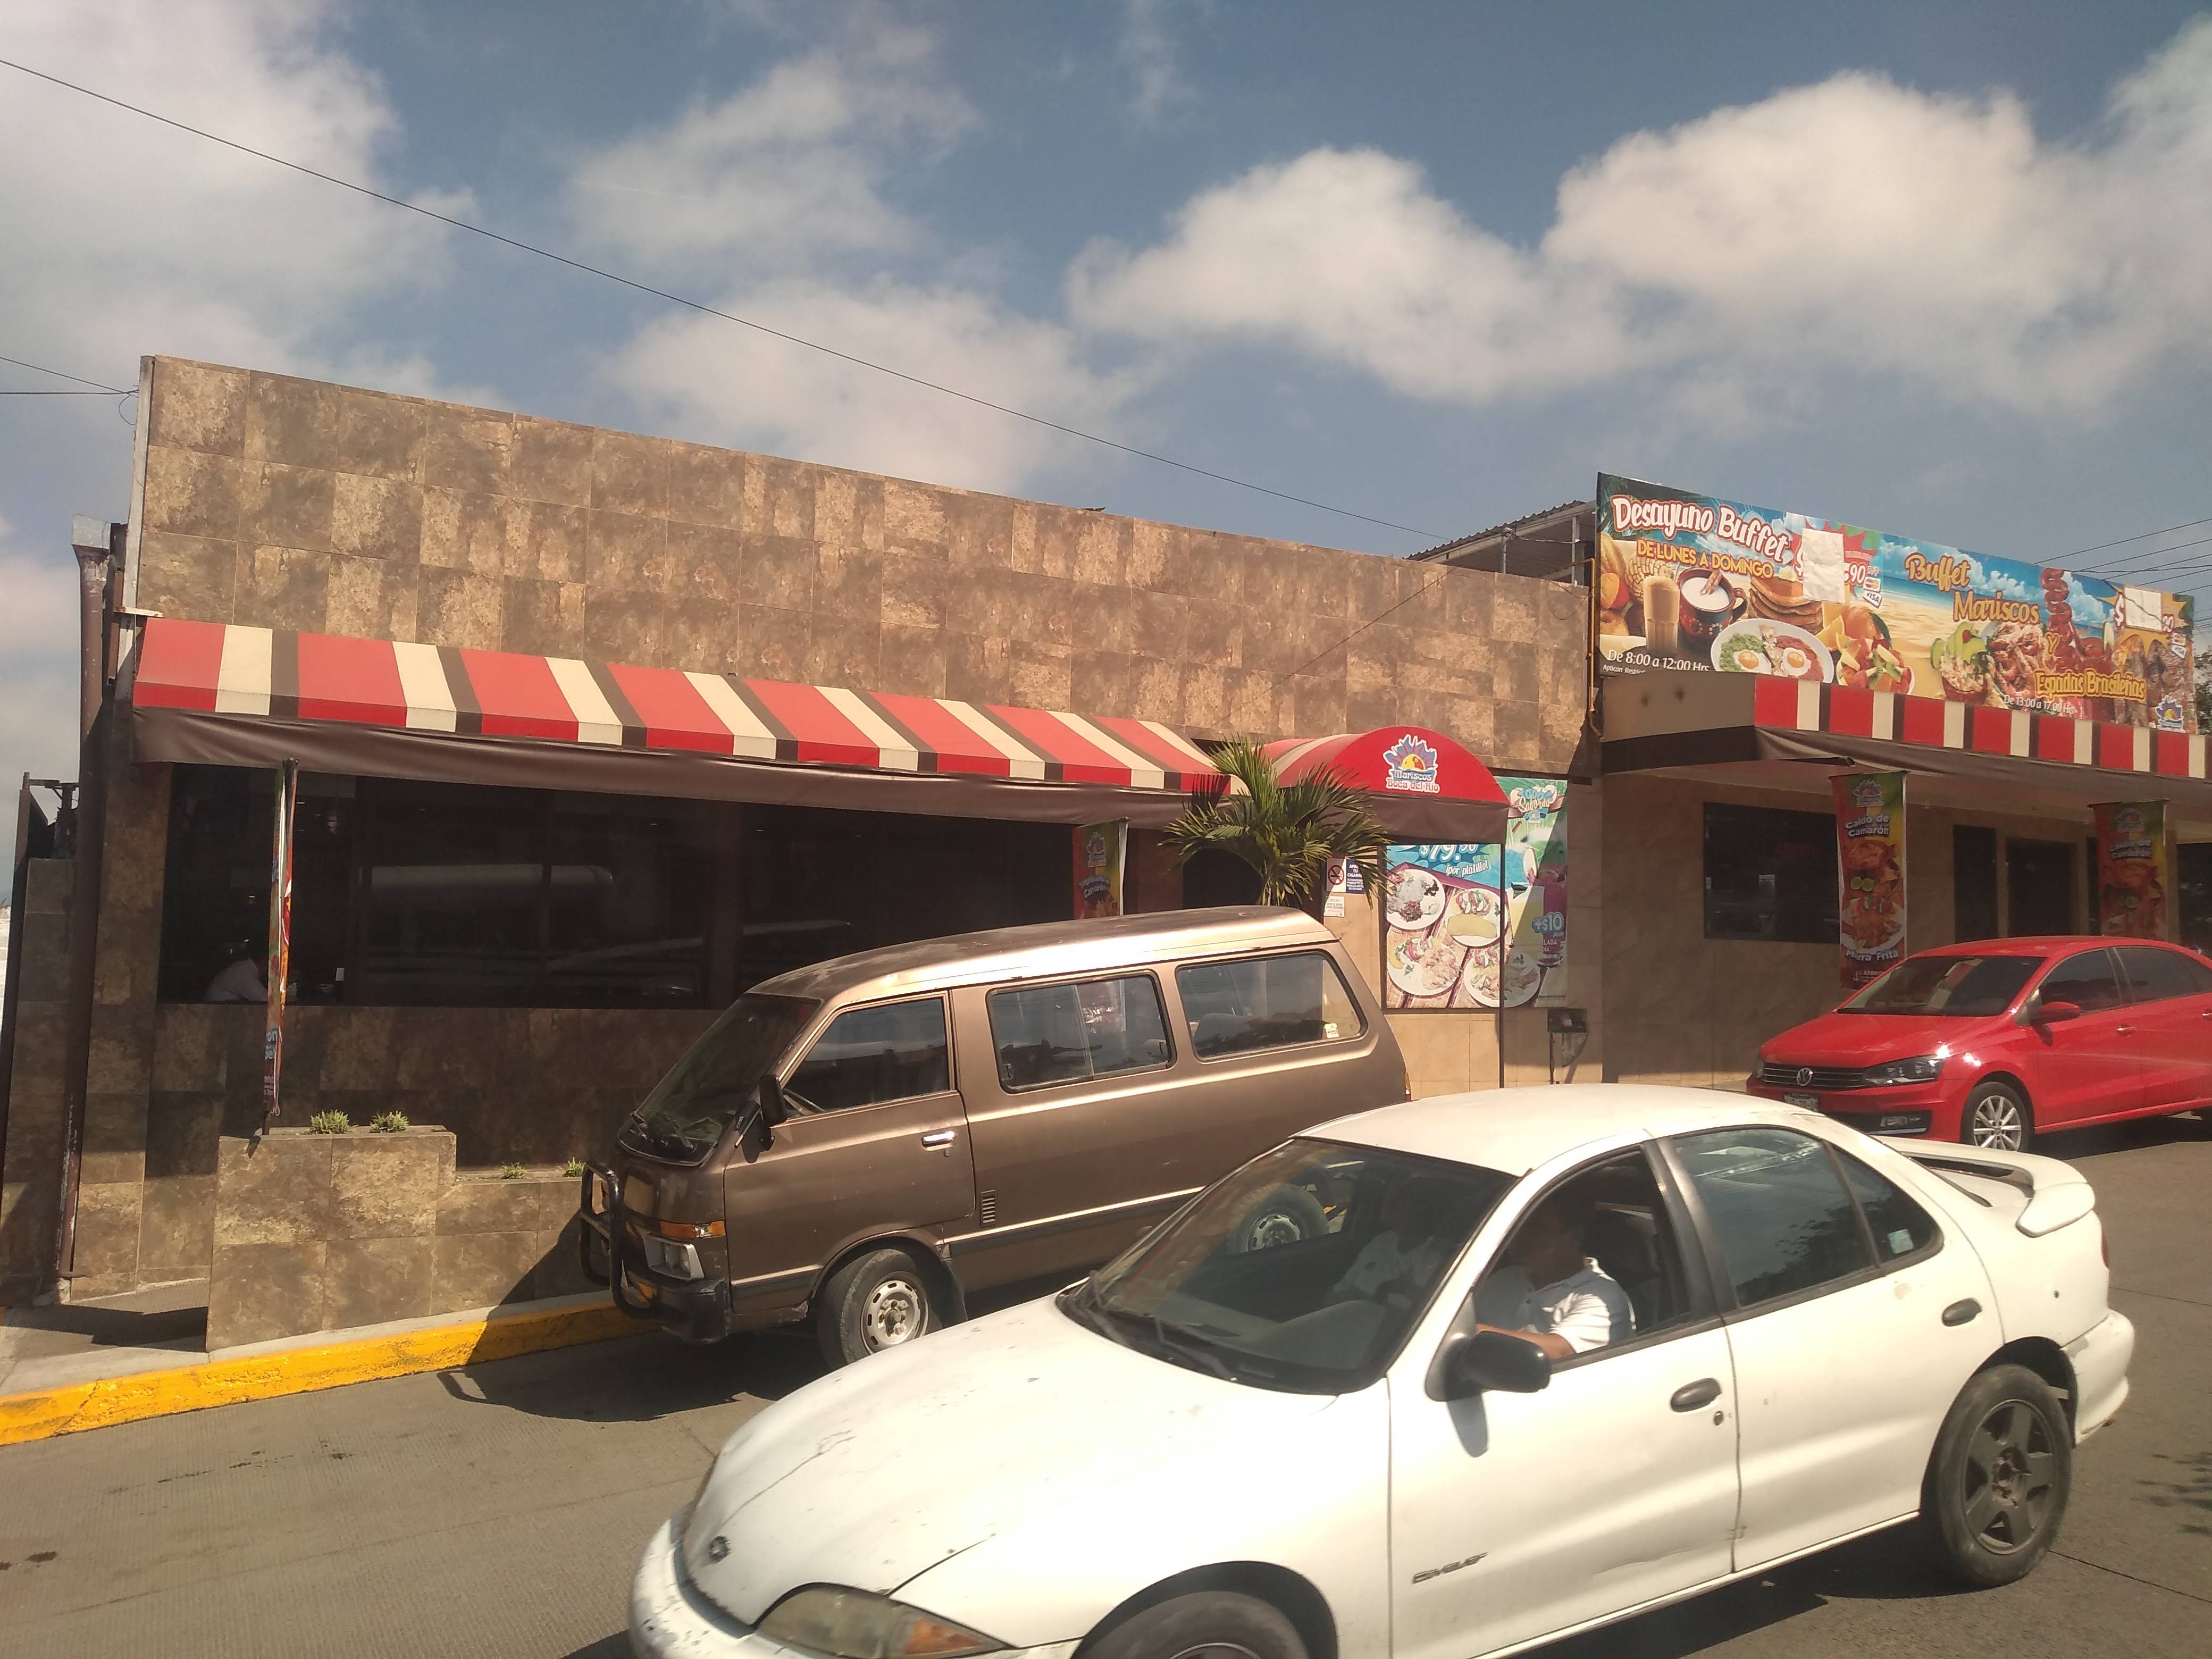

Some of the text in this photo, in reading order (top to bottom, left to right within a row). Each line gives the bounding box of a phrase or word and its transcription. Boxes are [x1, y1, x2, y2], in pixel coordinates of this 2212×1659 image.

[1612, 496, 1789, 563] Desayuno Buffet
[1638, 540, 1774, 579] DE LUNES A DOMINGO
[1905, 554, 1970, 592] Buffet
[1866, 592, 1880, 604] VISA
[1954, 590, 2040, 624] Mariscos
[1608, 649, 1623, 663] De
[1626, 651, 1650, 666] 8:00
[1652, 657, 1660, 667] a
[1662, 657, 1691, 671] 12:00
[2036, 669, 2146, 698] Espadas Brasileñas
[2004, 694, 2014, 705] De
[2016, 696, 2035, 708] 13:00
[2036, 700, 2042, 709] a
[1387, 778, 1407, 788] Boca
[1410, 781, 1422, 790] del
[1394, 769, 1432, 781] Mariscos
[1846, 814, 1889, 829] Caldo de
[1848, 825, 1889, 837] Camarón
[1462, 859, 1488, 877] platillo!
[1534, 914, 1563, 932] +$10
